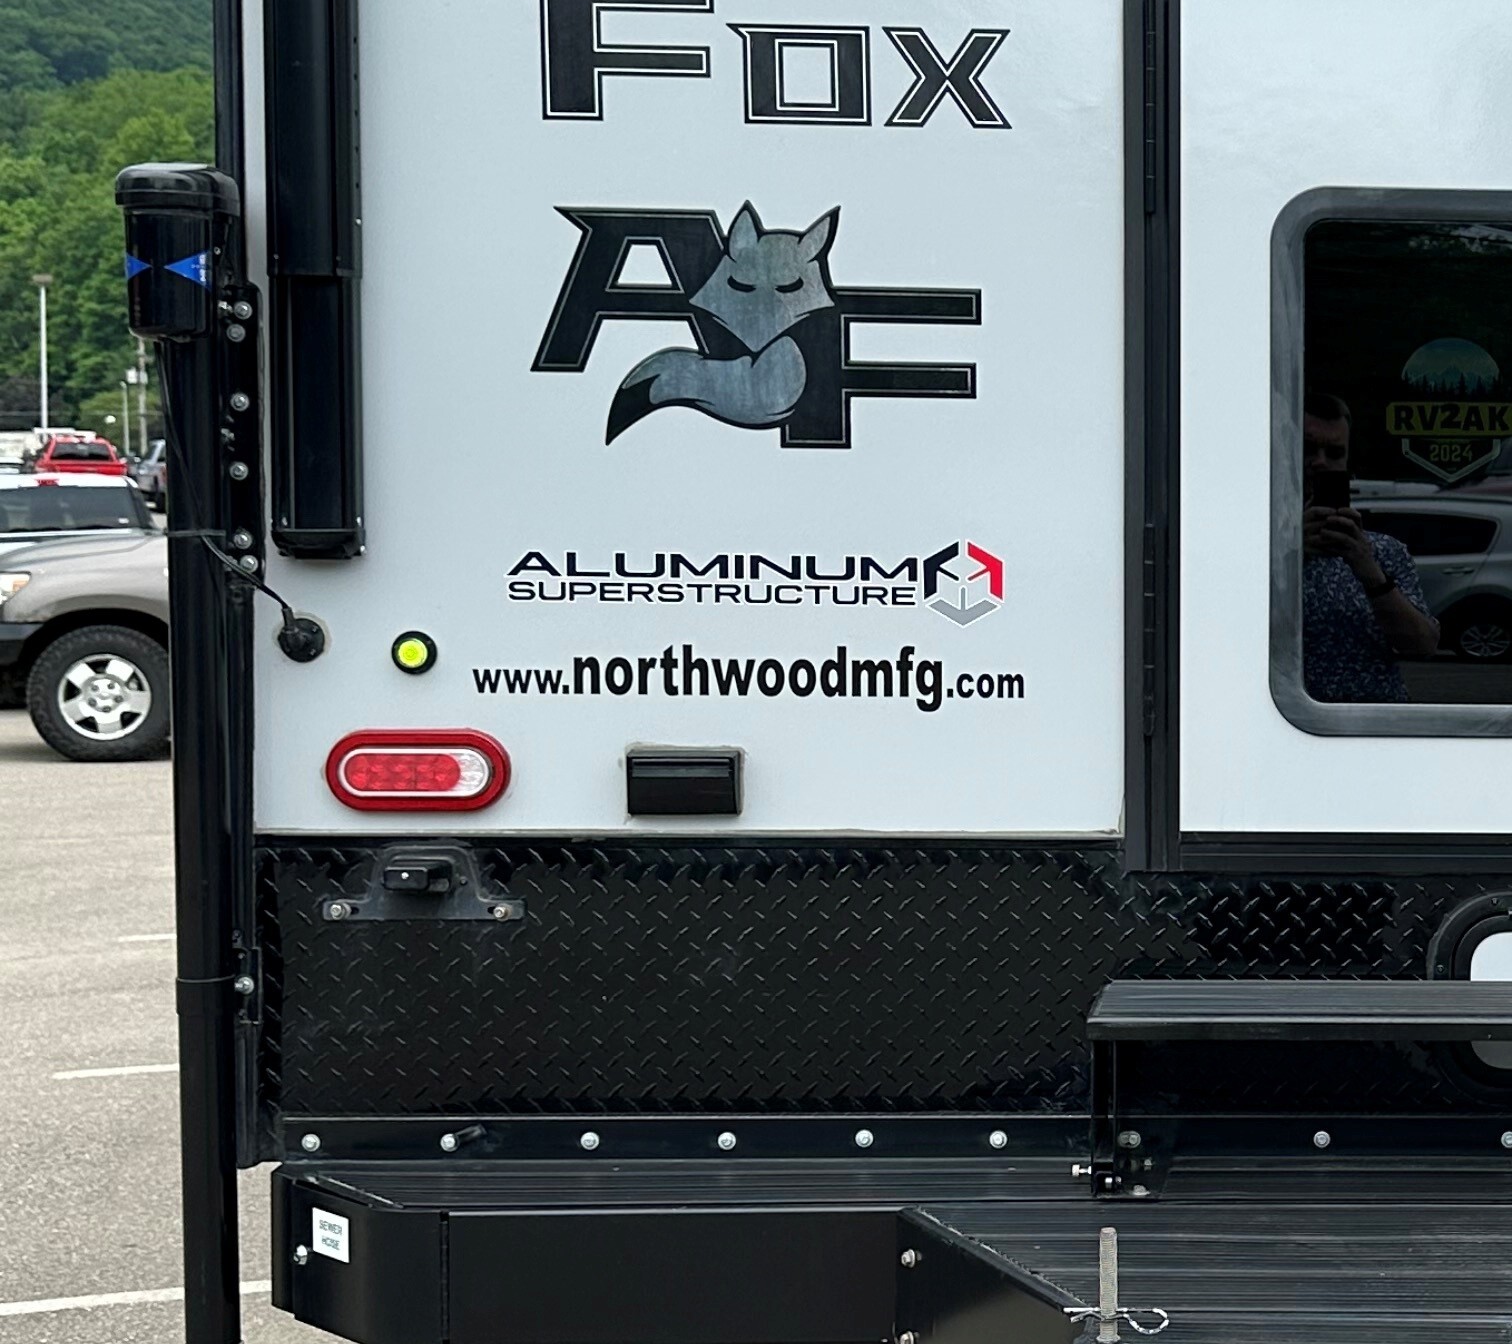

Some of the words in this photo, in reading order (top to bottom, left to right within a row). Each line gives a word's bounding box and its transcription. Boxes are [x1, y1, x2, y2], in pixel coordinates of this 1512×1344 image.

[1394, 404, 1510, 432] RV2AK
[1429, 445, 1473, 462] 2024
[507, 551, 918, 582] ALUMINUM
[508, 581, 917, 607] SUPERSTRUCTURE
[472, 644, 1025, 713] www.northwoodmfg.com
